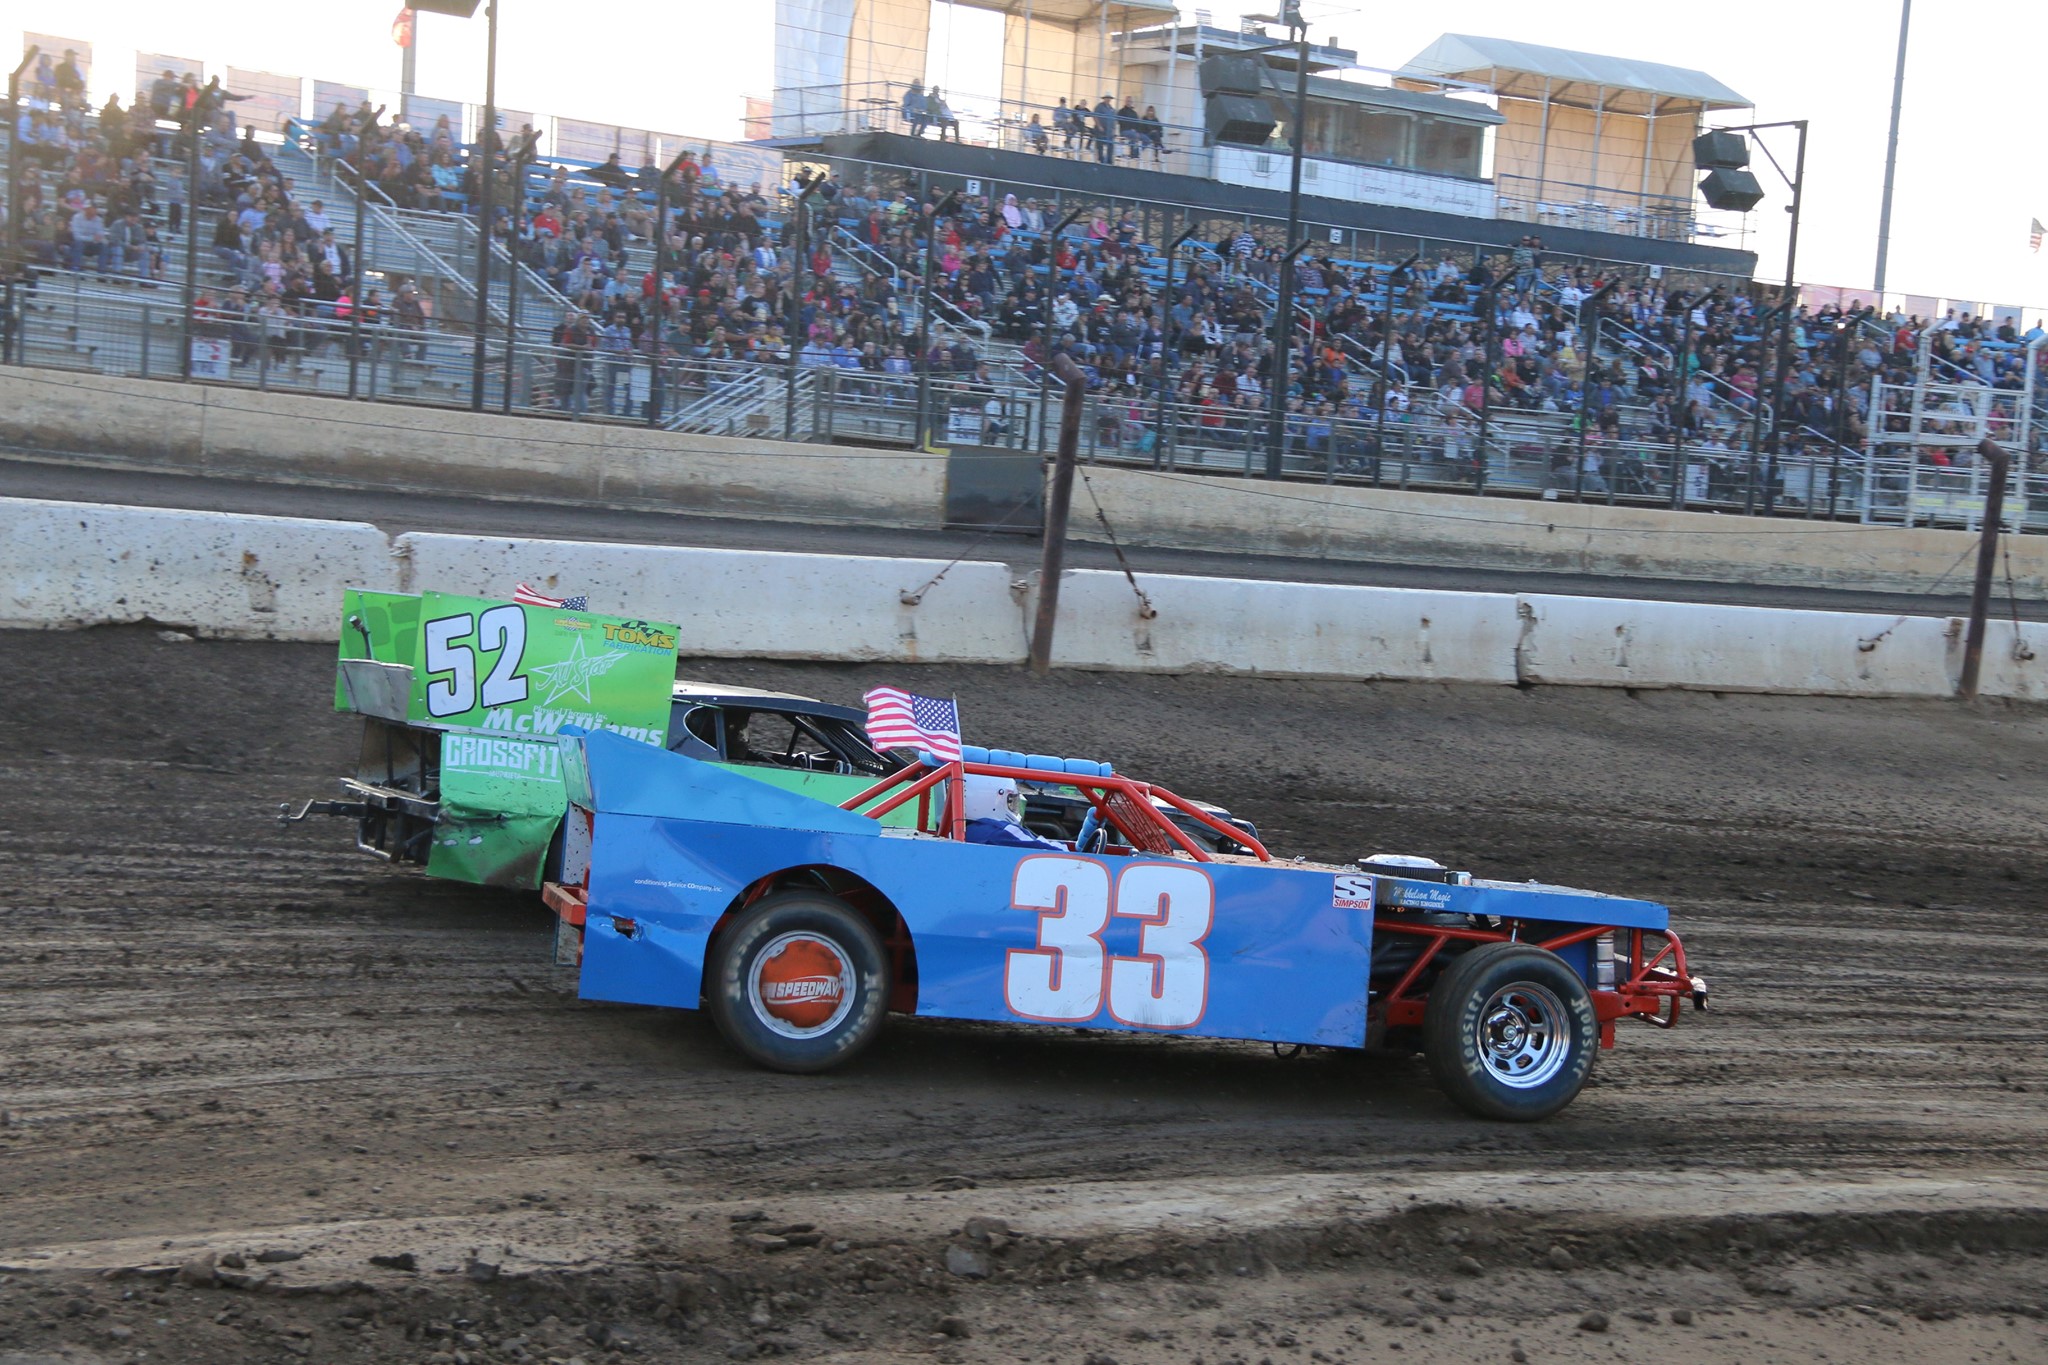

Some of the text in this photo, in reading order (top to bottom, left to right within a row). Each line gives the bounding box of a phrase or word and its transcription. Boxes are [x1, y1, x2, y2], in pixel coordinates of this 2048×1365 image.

[602, 623, 675, 649] TOMS
[603, 640, 672, 656] FABRICATION
[424, 604, 529, 718] 52
[445, 735, 561, 777] CROSSFIT
[668, 880, 686, 888] Service
[1334, 899, 1369, 909] SIMPSON
[1004, 853, 1216, 1030] 33
[775, 980, 840, 999] SPEEDWAY
